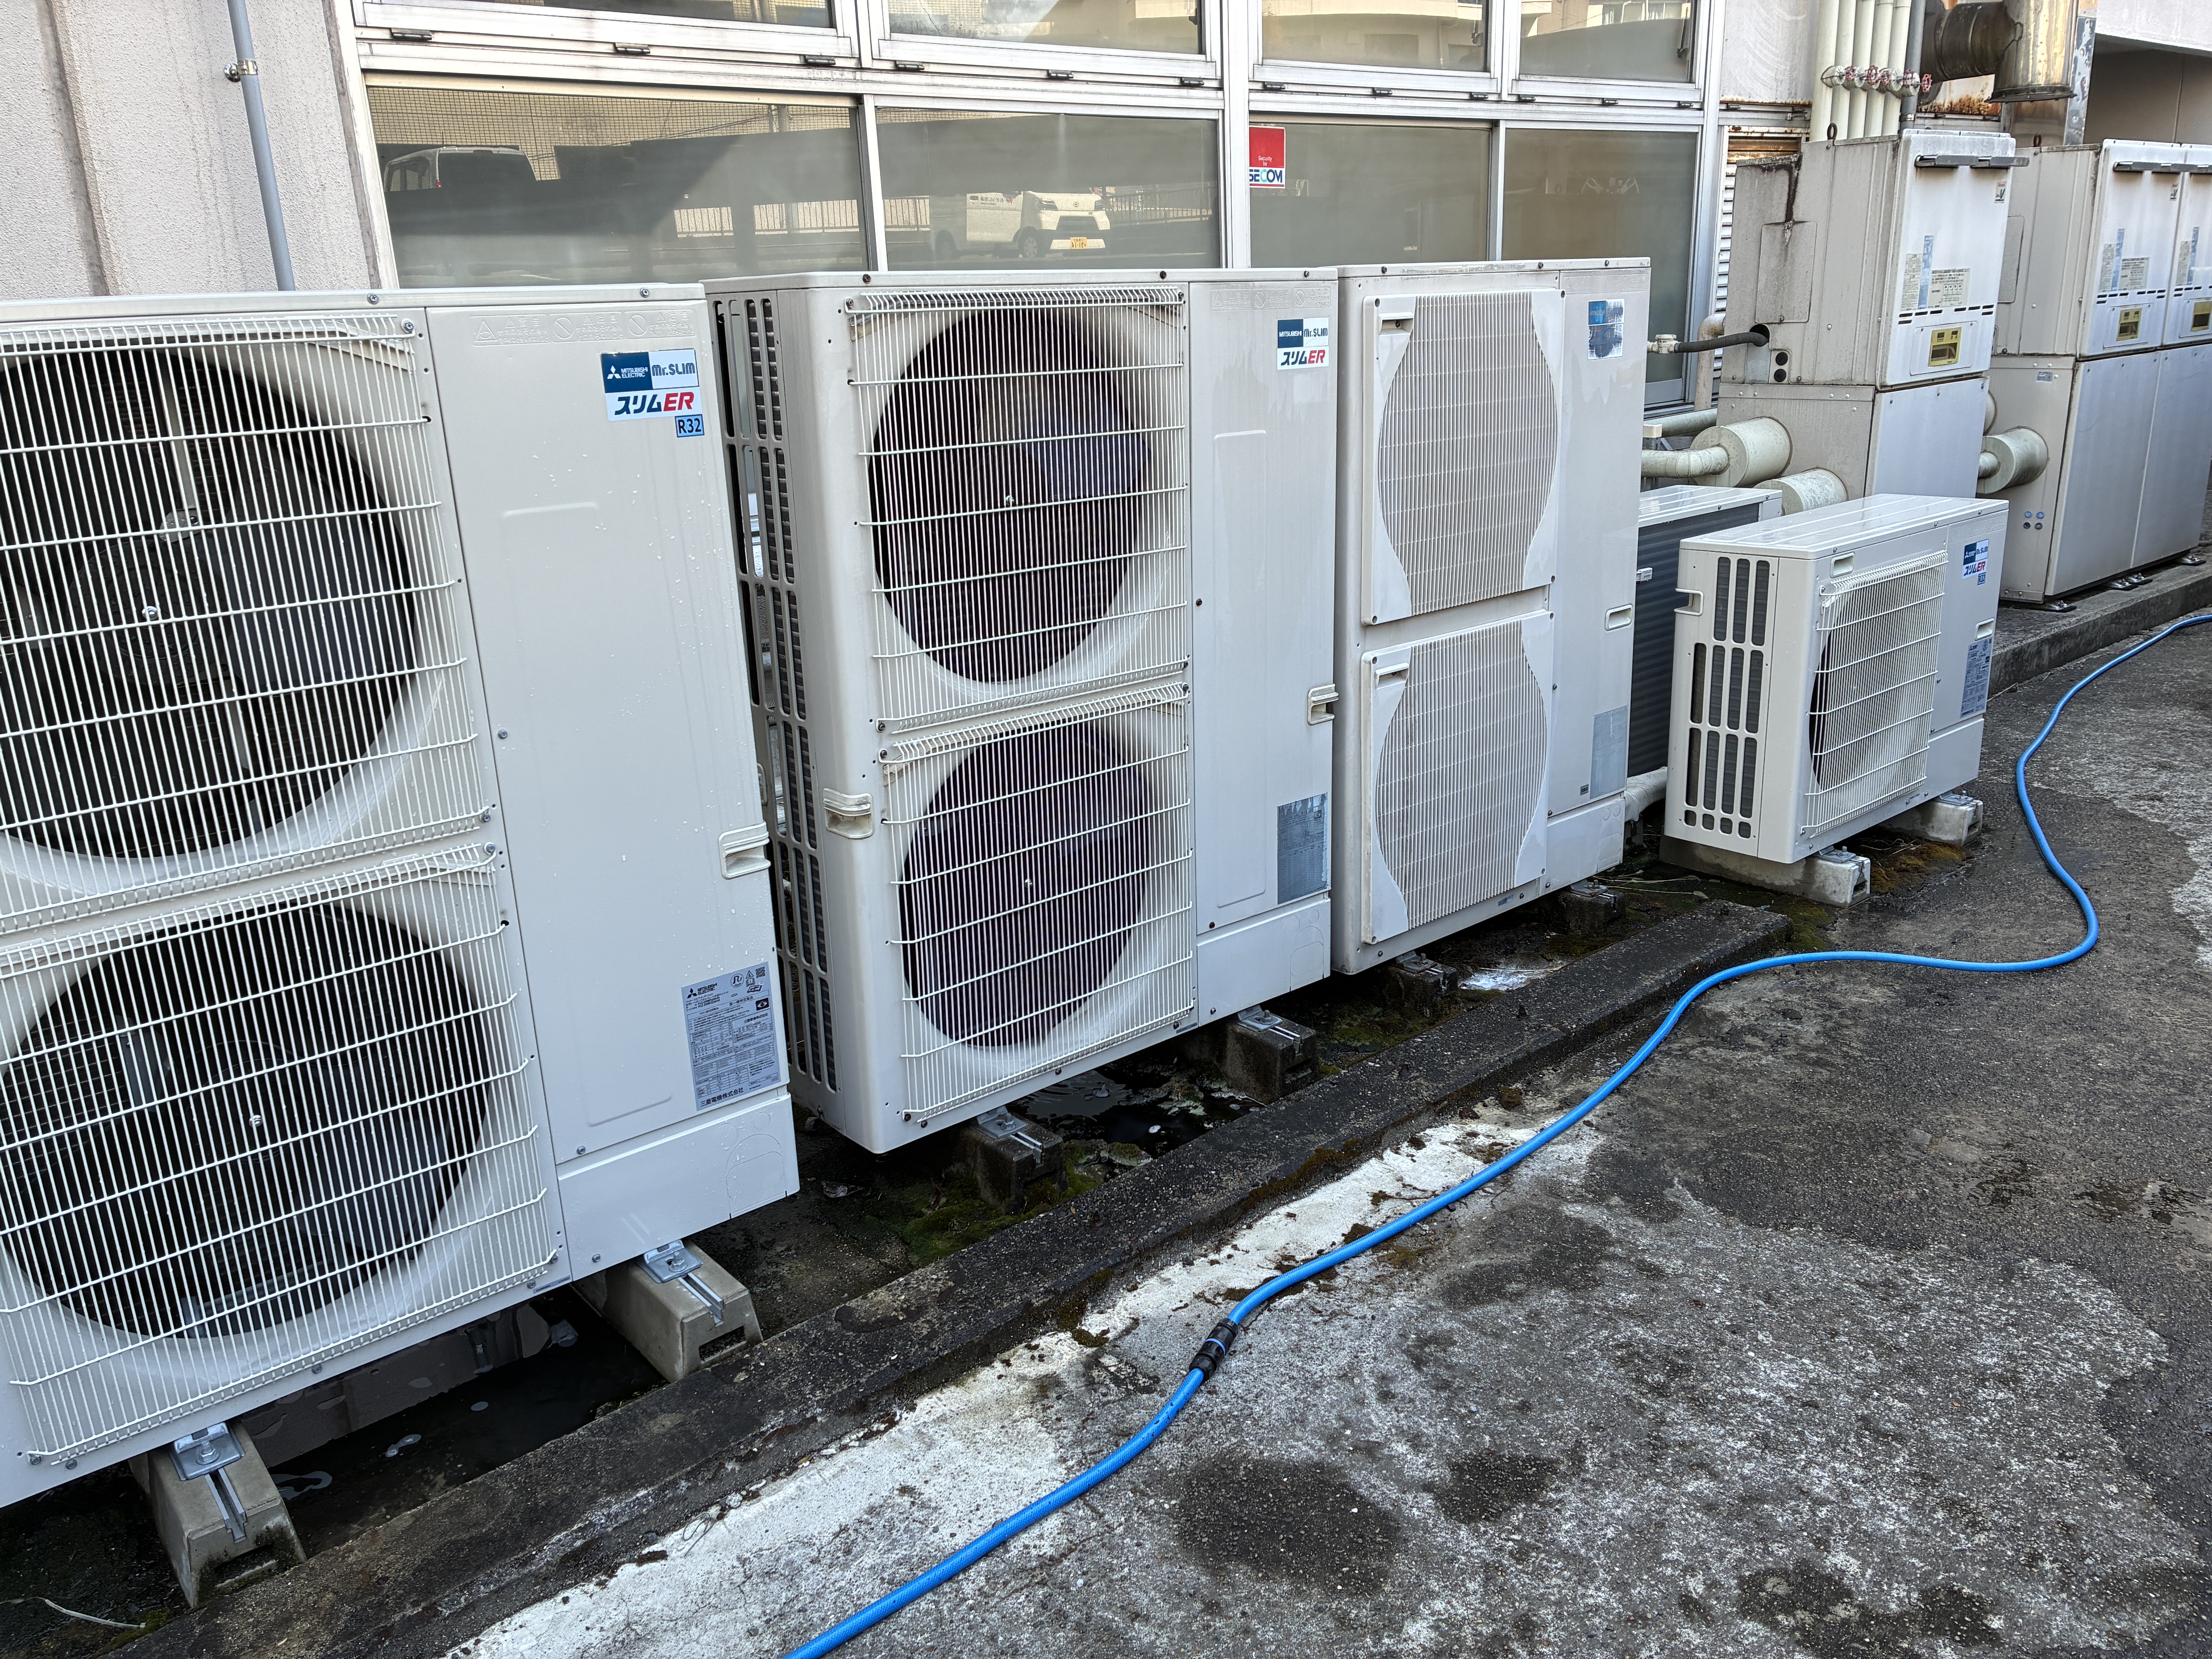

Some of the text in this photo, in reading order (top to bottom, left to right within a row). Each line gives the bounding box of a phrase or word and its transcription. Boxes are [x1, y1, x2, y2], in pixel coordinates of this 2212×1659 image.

[1281, 350, 1326, 366] スリムER
[652, 362, 696, 376] Mr.SLIM
[614, 392, 694, 415] スリムER
[678, 418, 702, 434] R32
[700, 1087, 744, 1107] 三菱電機株式会社
